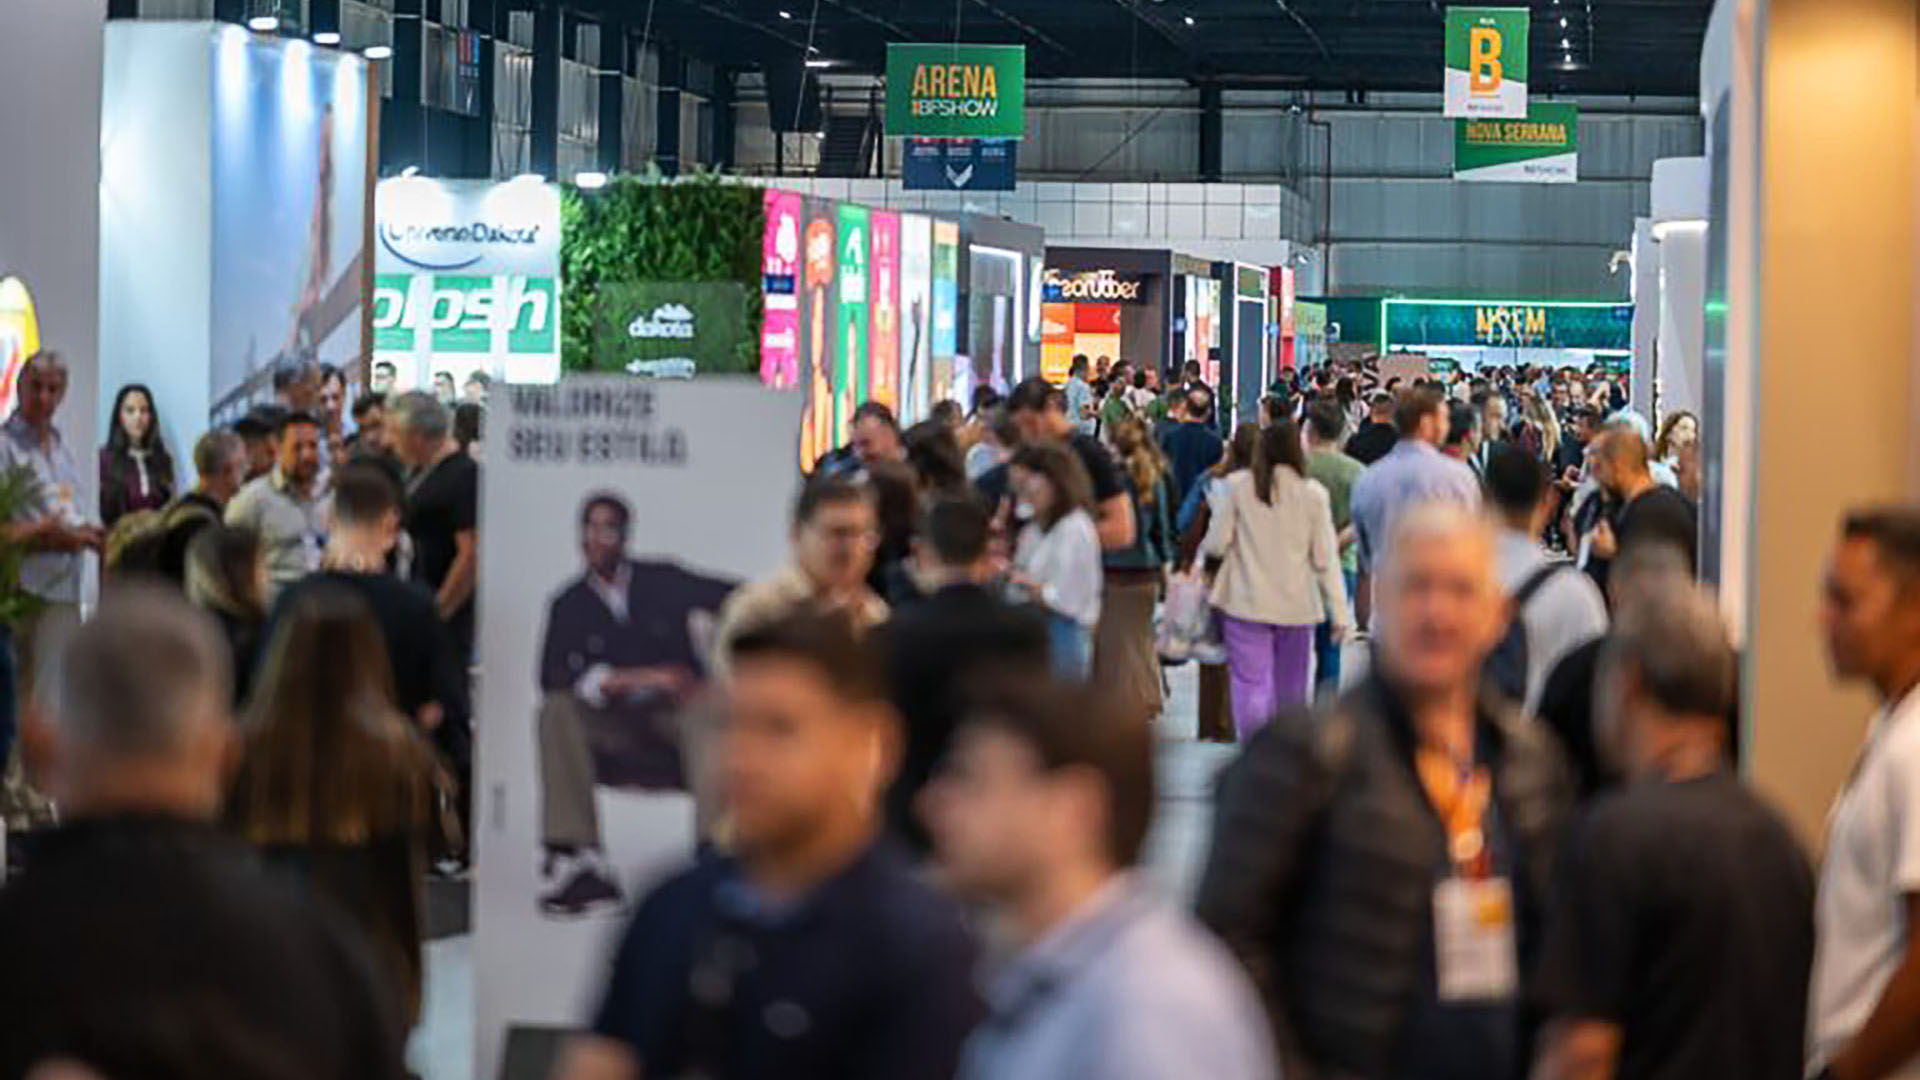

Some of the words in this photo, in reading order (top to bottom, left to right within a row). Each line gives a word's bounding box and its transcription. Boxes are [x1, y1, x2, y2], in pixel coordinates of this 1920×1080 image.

[1470, 27, 1502, 93] B
[911, 63, 997, 98] ARENA
[1466, 122, 1501, 143] NOVA
